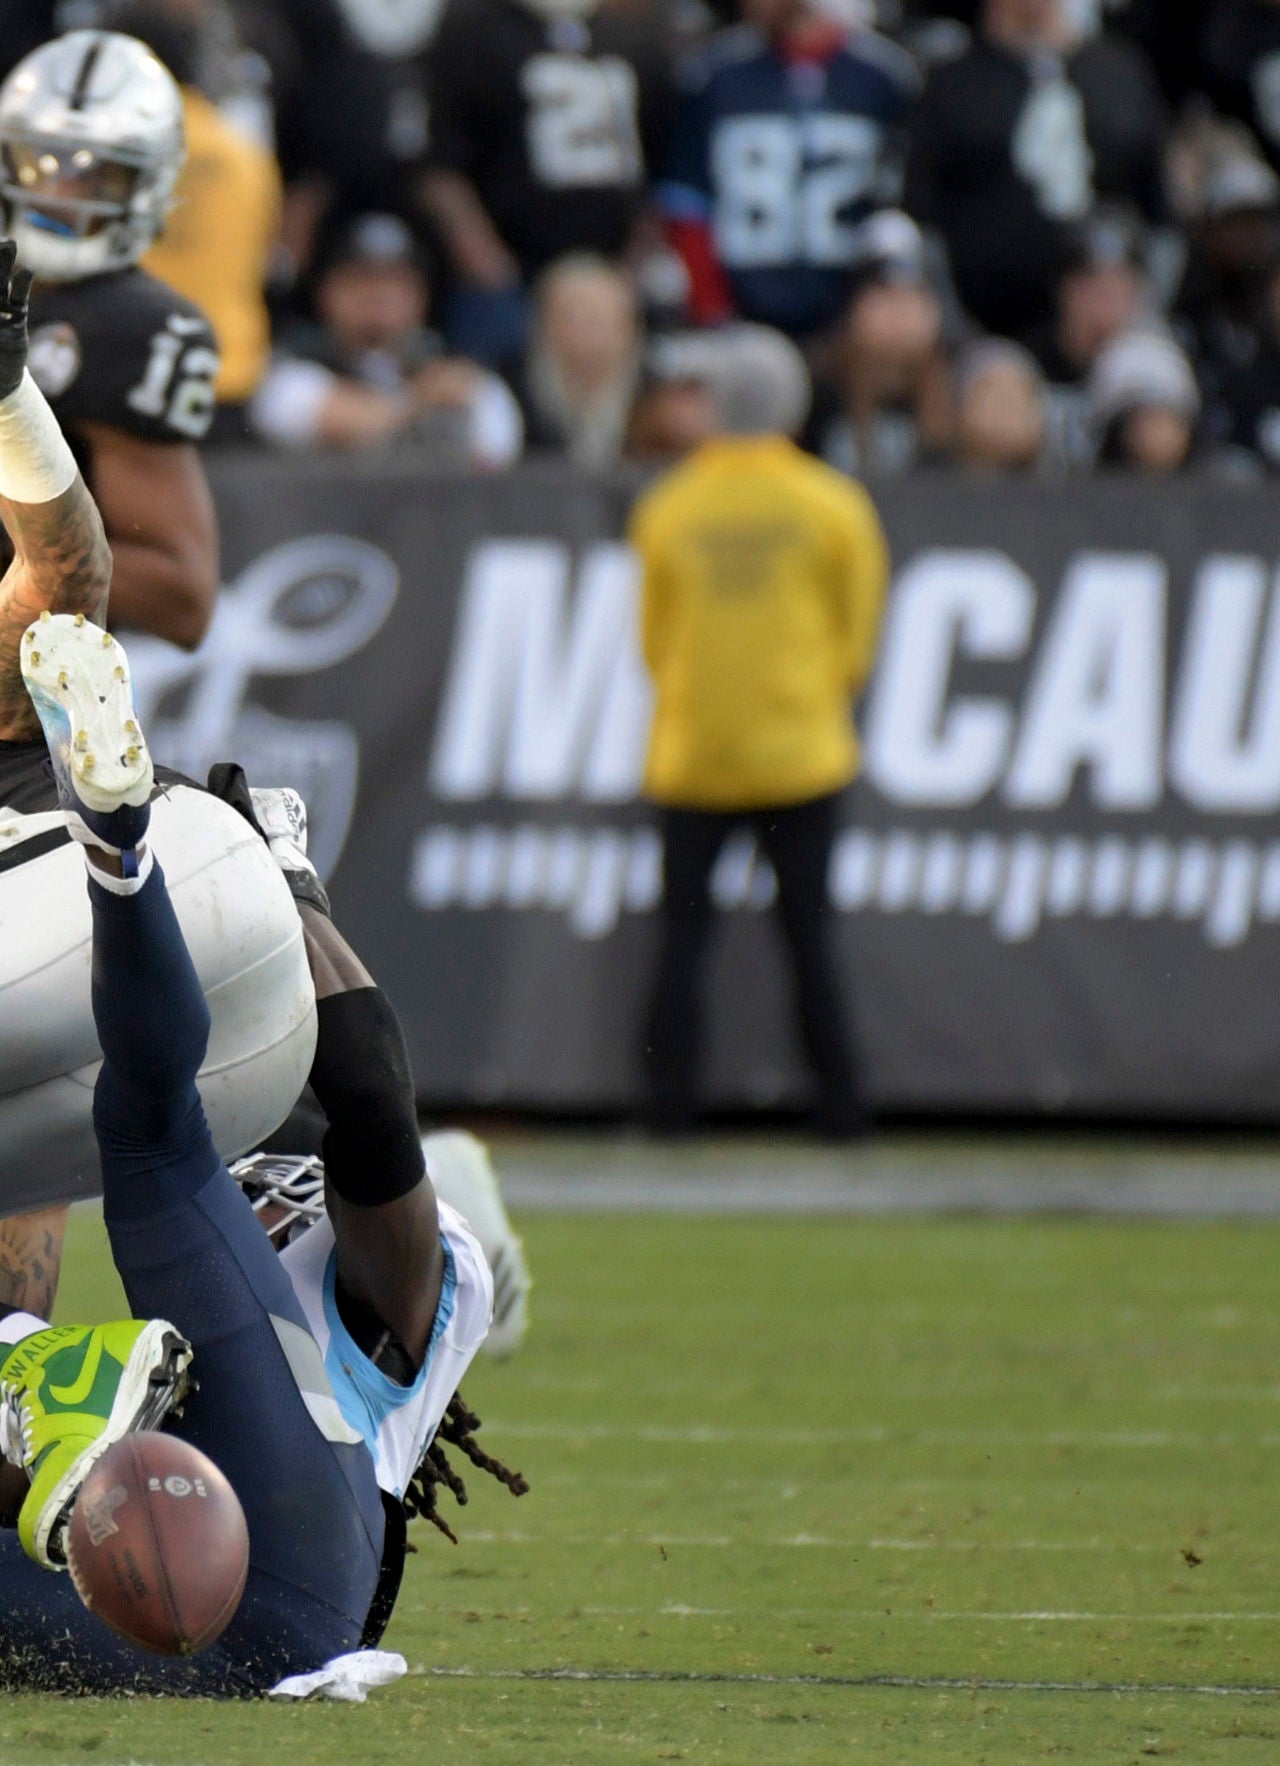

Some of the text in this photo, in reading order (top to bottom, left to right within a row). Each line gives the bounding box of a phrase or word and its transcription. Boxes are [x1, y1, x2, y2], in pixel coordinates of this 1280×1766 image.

[709, 113, 884, 267] 82
[127, 331, 219, 440] 12
[426, 536, 1280, 812] MCAU
[7, 1326, 77, 1379] WALLER
